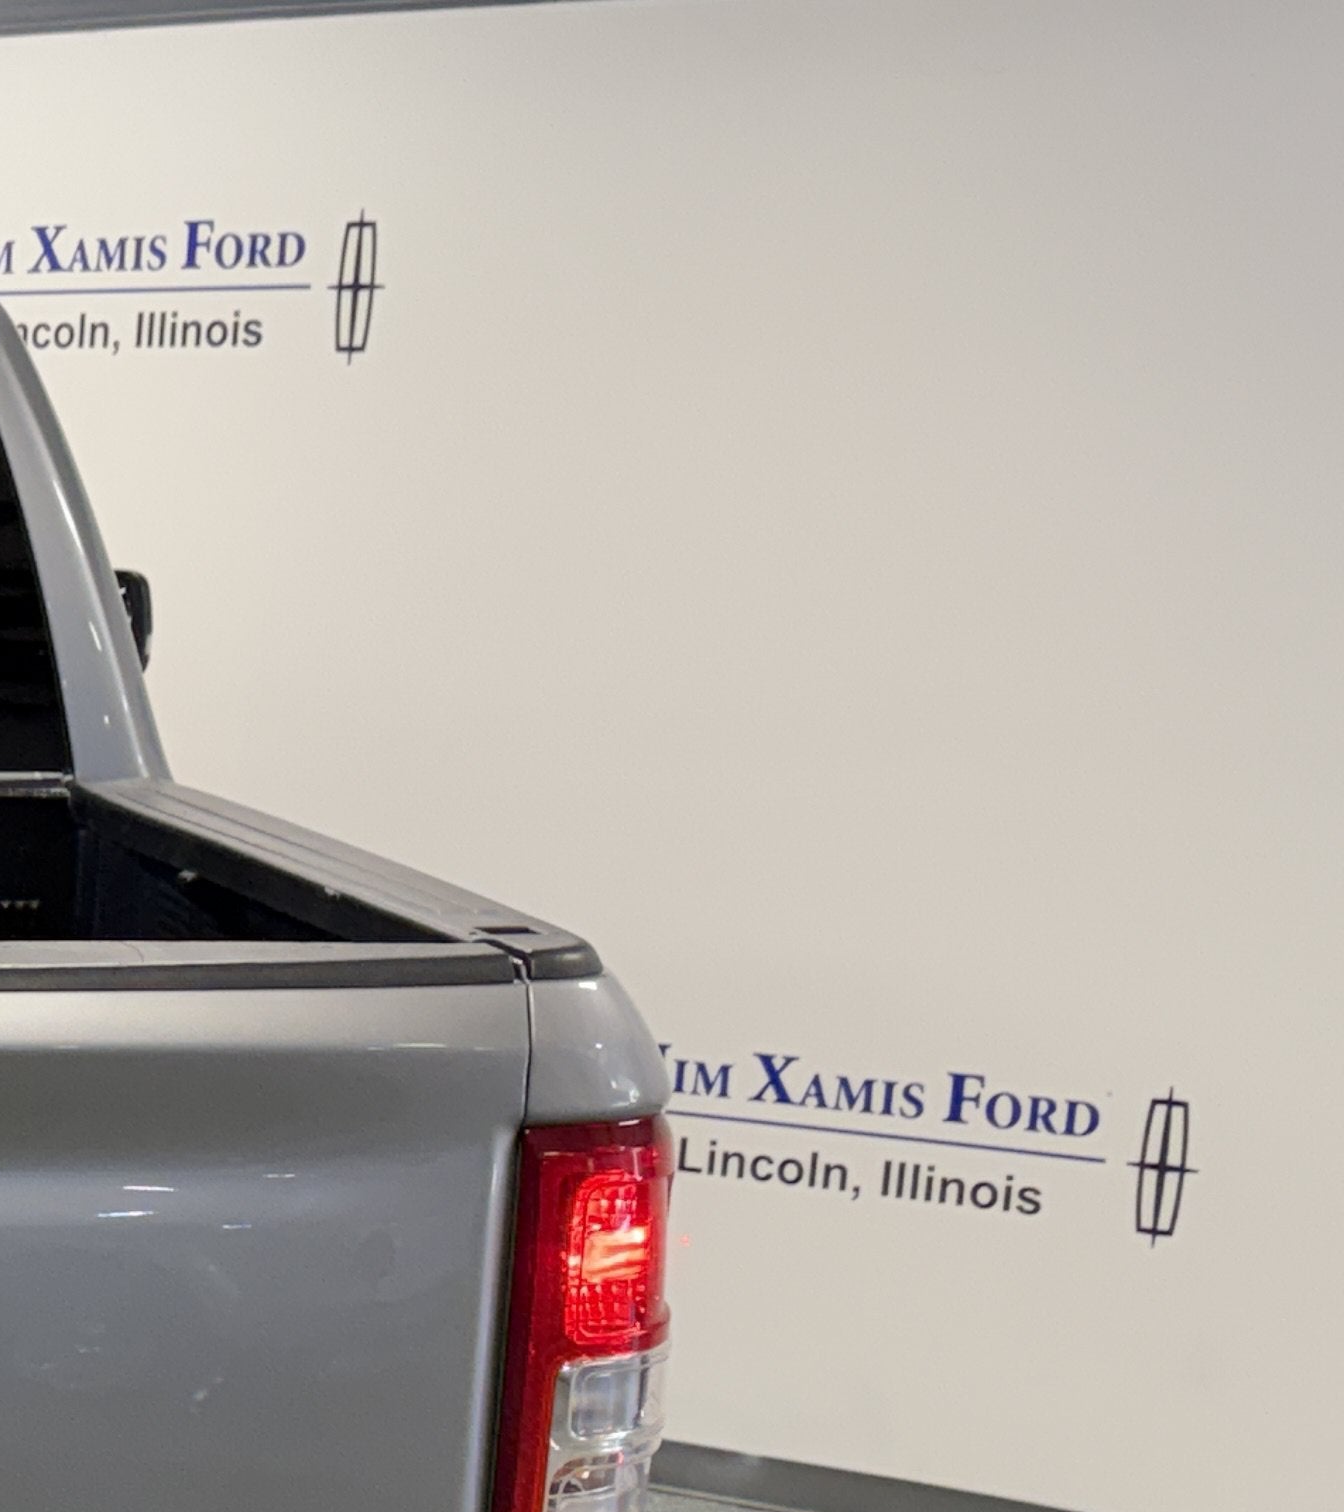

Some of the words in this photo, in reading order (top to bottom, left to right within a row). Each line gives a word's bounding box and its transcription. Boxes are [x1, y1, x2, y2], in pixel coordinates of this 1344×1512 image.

[27, 225, 168, 274] XAMIS
[181, 219, 306, 271] FORD
[134, 311, 264, 348] Illinois
[657, 1043, 733, 1098] IM
[747, 1052, 925, 1119] XAMIS
[942, 1072, 1101, 1138] FORD
[677, 1136, 862, 1201] Lincoln,
[880, 1160, 1043, 1216] Illinois
